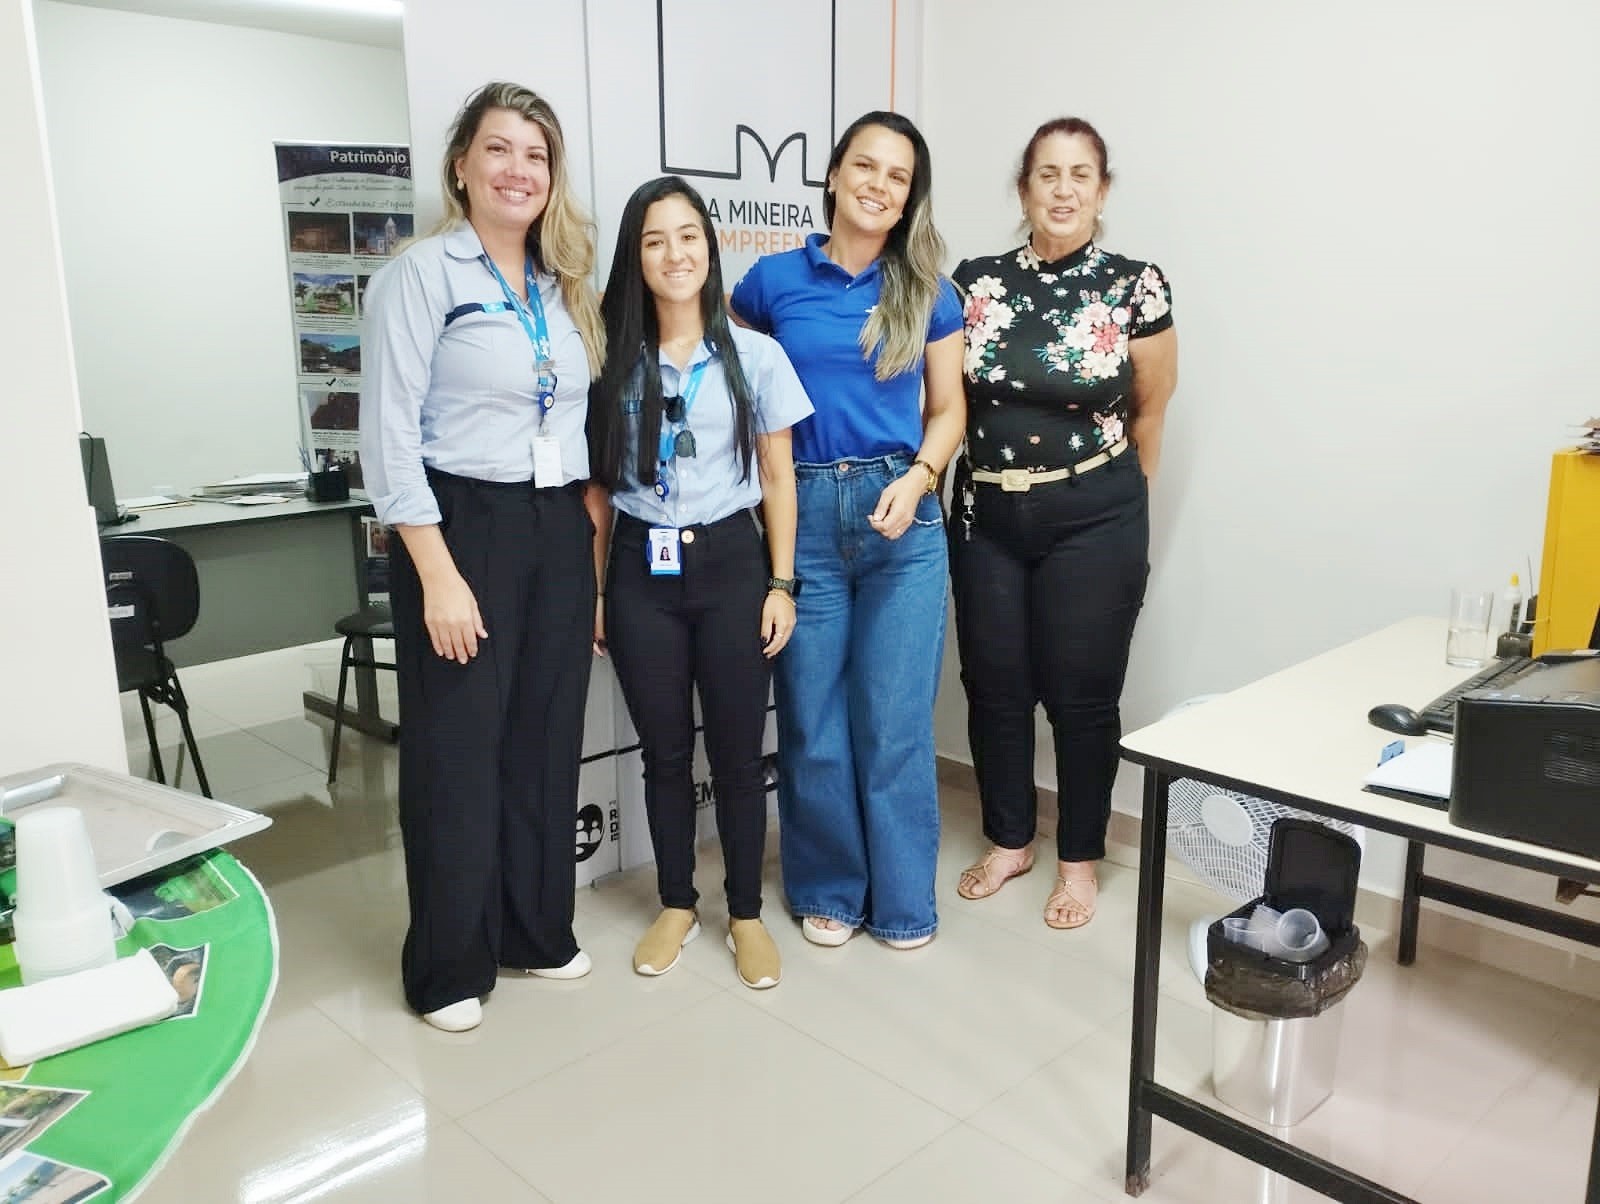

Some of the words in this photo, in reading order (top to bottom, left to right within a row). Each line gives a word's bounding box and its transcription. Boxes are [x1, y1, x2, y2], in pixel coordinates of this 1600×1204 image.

[330, 150, 406, 163] Patrimônio
[708, 198, 721, 222] A
[729, 199, 813, 228] MINEIRA
